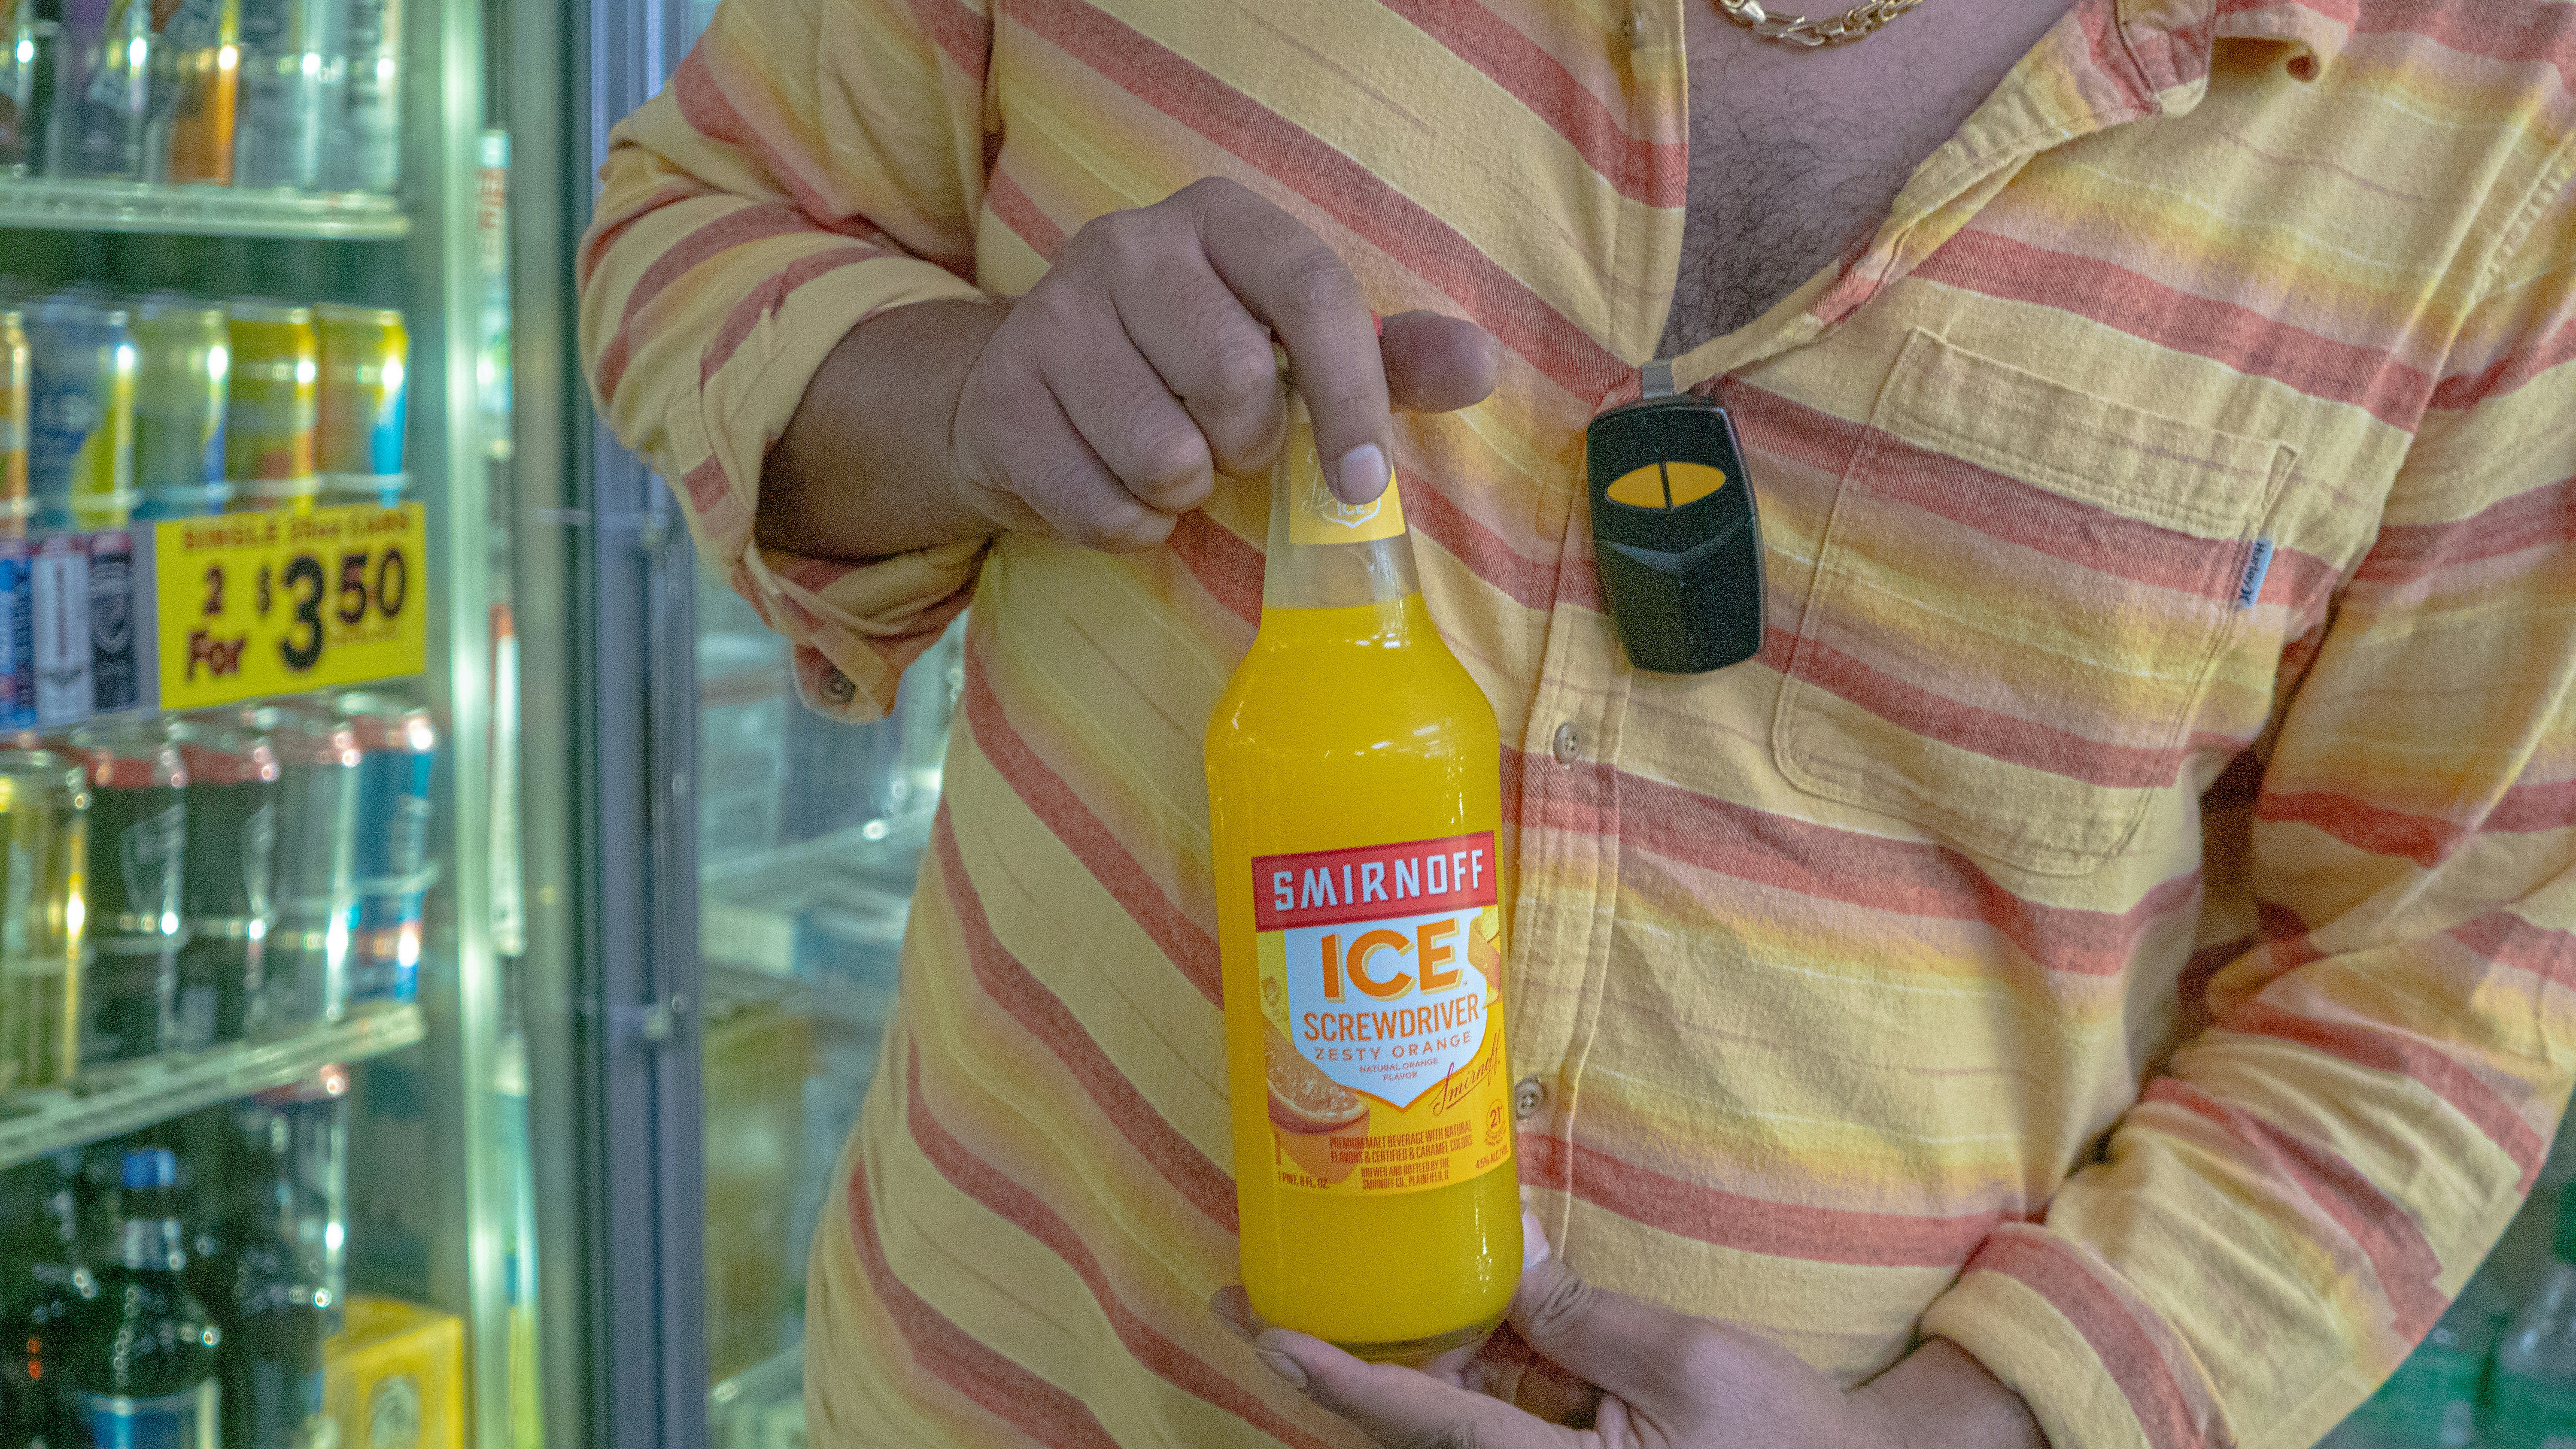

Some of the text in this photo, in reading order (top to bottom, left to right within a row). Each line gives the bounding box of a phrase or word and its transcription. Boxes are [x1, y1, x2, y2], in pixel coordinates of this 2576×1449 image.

[1273, 849, 1483, 910] SMIRNOFF
[1321, 917, 1464, 1003] ICE
[1303, 993, 1479, 1042] SCREWDRIVER
[1315, 1031, 1471, 1062] ZESTY ORANGE
[1359, 1057, 1438, 1073] NATURAL ORANGE
[1383, 1071, 1418, 1081] FLAVOR
[1429, 1028, 1501, 1116] Smirnoff
[1329, 1136, 1364, 1150] PREMIUM
[1366, 1135, 1386, 1149] MALT
[1388, 1131, 1424, 1147] BEVERAGE
[1425, 1128, 1443, 1143] WITH
[1444, 1119, 1471, 1139] NATURAL
[1331, 1150, 1363, 1164] FLAVORS
[1364, 1151, 1370, 1163] &
[1372, 1148, 1407, 1163] CERTIFIED
[1409, 1147, 1415, 1159] &
[1416, 1142, 1449, 1158] CARAMEL
[1450, 1134, 1473, 1152] COLORS
[1361, 1157, 1449, 1178] BREWED AND BOTTLED BY THE
[1362, 1178, 1395, 1190] SMIRNOFF
